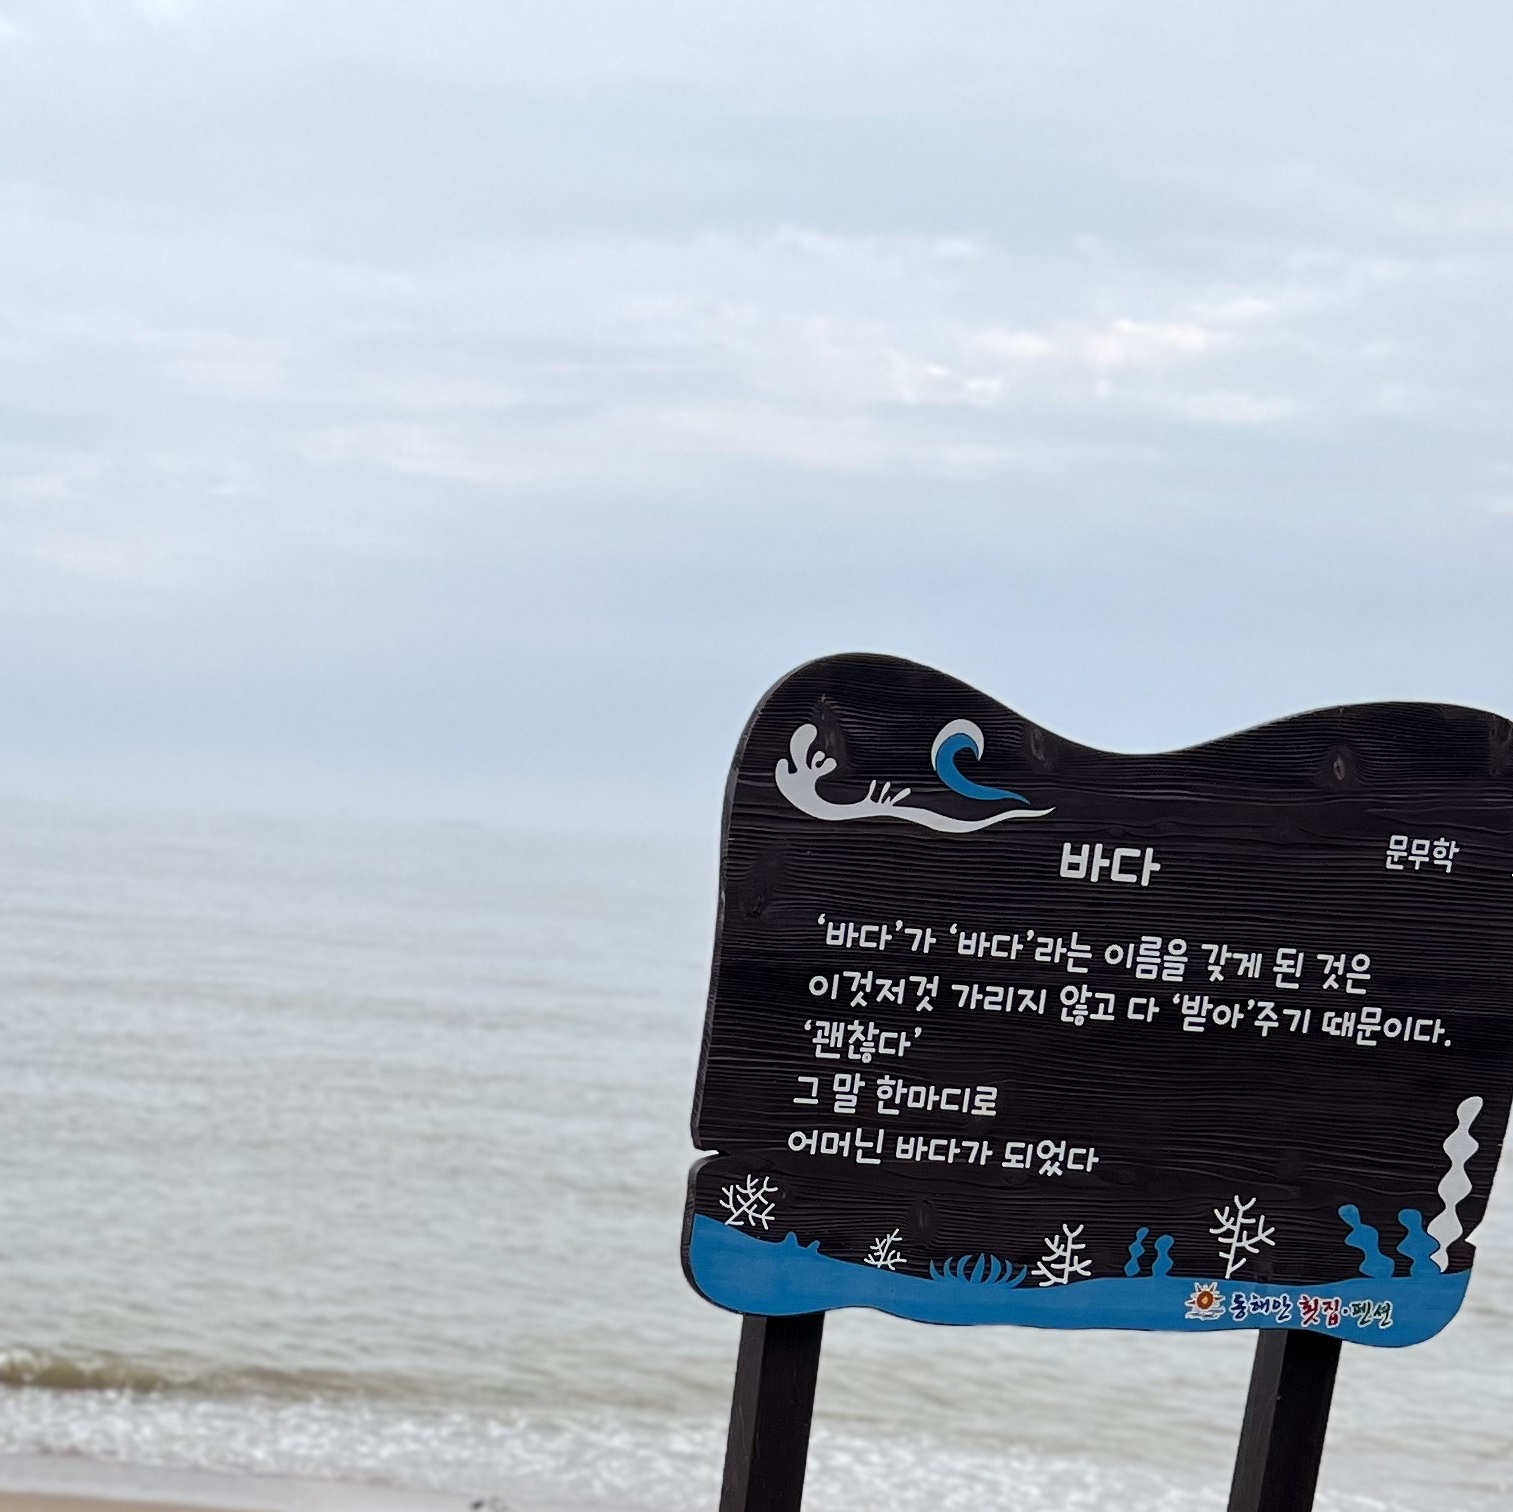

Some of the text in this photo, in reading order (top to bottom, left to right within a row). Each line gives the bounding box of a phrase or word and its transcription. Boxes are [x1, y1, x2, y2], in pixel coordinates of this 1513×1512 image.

[1059, 842, 1161, 886] 바다
[1386, 835, 1460, 873] 문무학
[1104, 935, 1188, 982] 이름을
[1201, 944, 1262, 982] 갖게
[1273, 948, 1304, 989] 된
[1317, 953, 1371, 995] 것은
[808, 970, 939, 1012] 이것저것
[951, 983, 1046, 1014] 가리지
[1060, 984, 1115, 1026] 않고
[1127, 997, 1159, 1023] 다
[1322, 1006, 1452, 1047] 때문이다.
[793, 1073, 998, 1116] 그 말 한마디로
[788, 1127, 1100, 1177] 어머닌 바다가 되었다
[1229, 1292, 1292, 1323] 동해안
